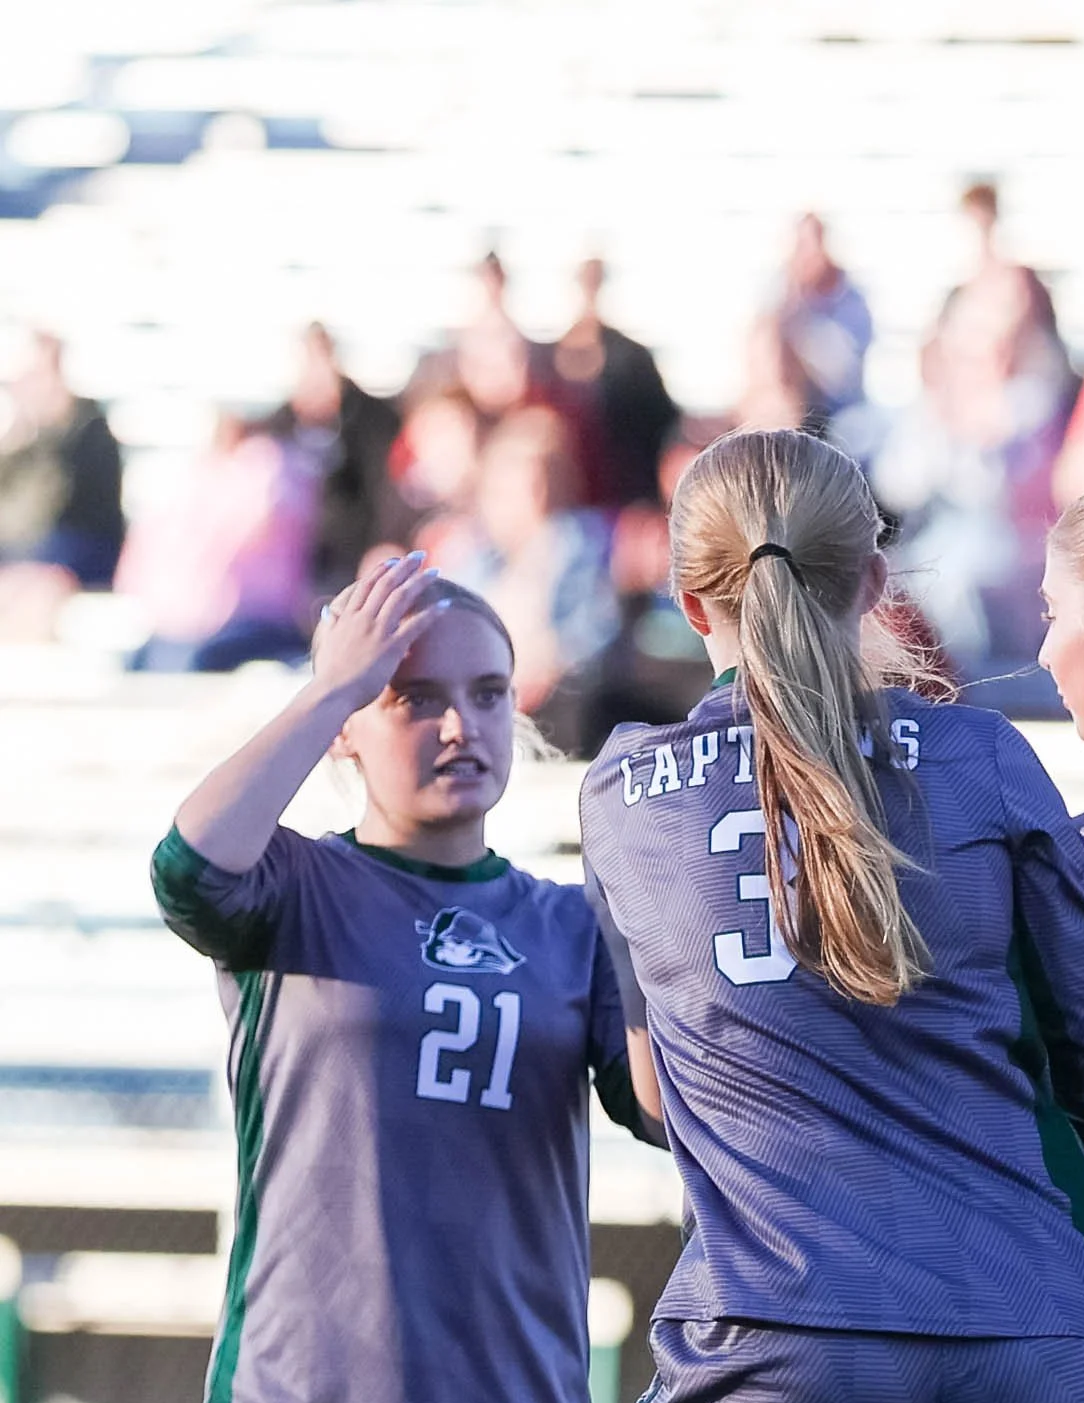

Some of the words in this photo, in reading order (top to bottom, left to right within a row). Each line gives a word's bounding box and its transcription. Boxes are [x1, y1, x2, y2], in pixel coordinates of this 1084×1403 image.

[620, 718, 920, 808] CAPTS
[710, 808, 800, 986] 3
[415, 981, 522, 1111] 21
